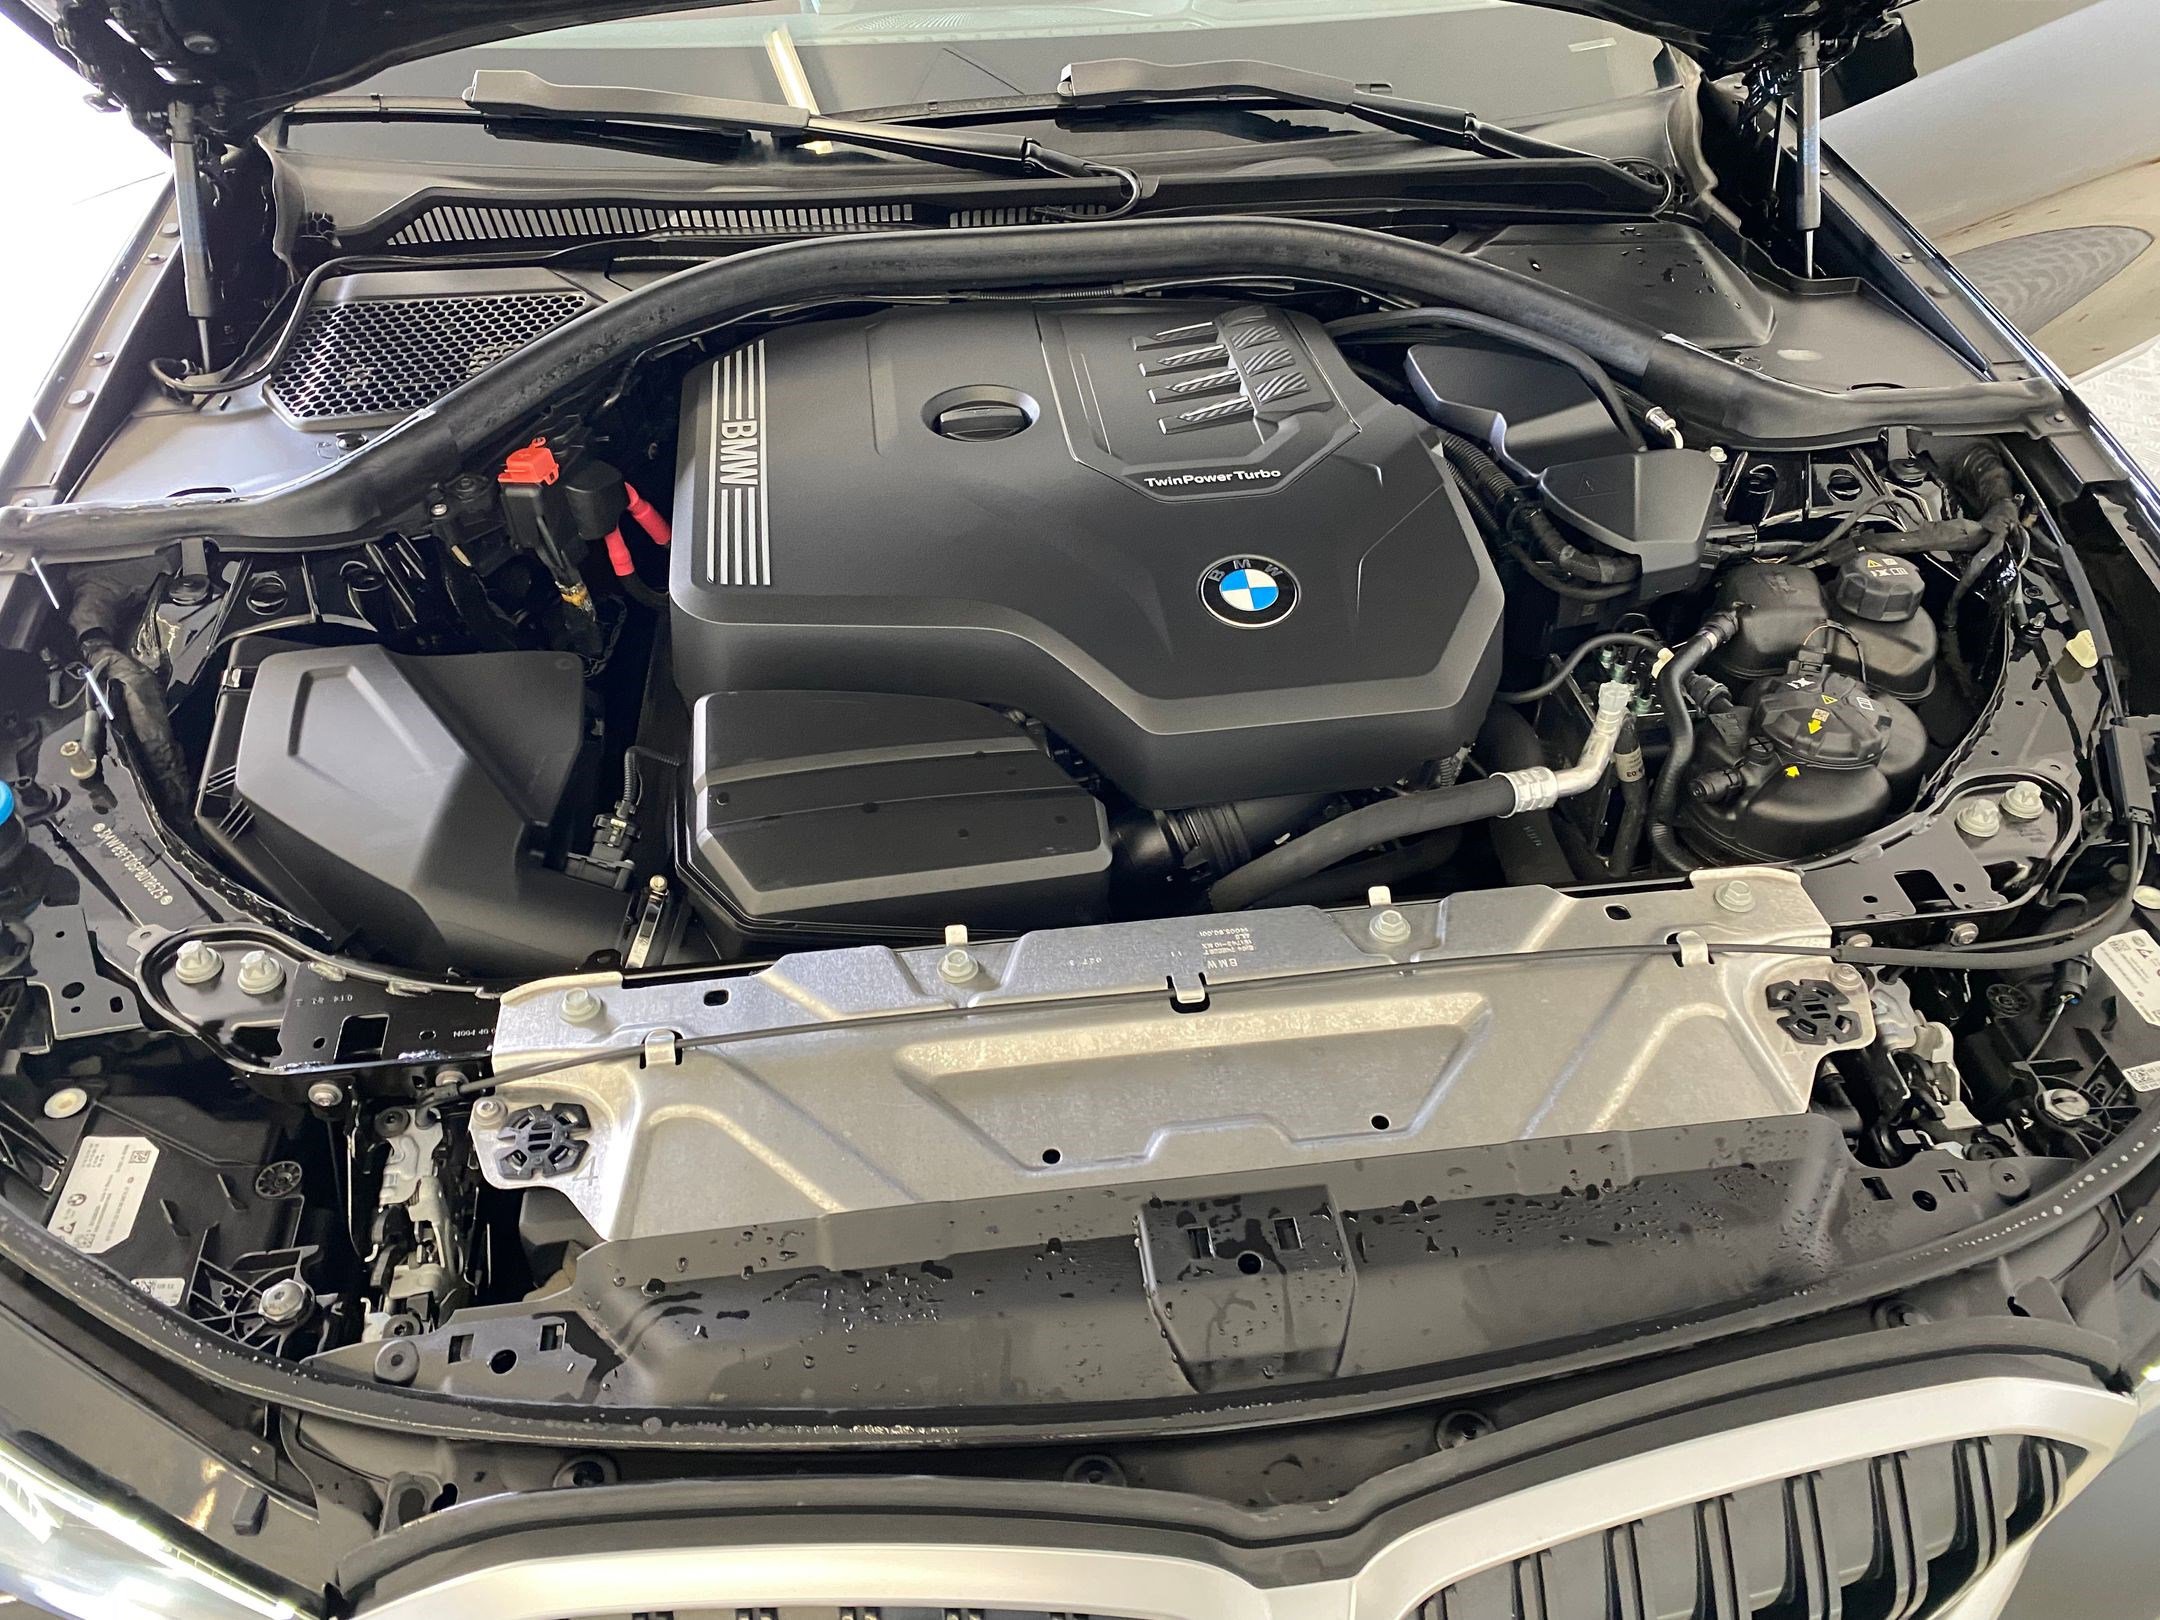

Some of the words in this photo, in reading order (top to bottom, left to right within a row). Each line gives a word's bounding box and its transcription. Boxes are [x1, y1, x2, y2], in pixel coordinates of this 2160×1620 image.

[720, 420, 758, 485] BMW
[1208, 558, 1284, 582] BMW
[1207, 958, 1238, 969] BMW
